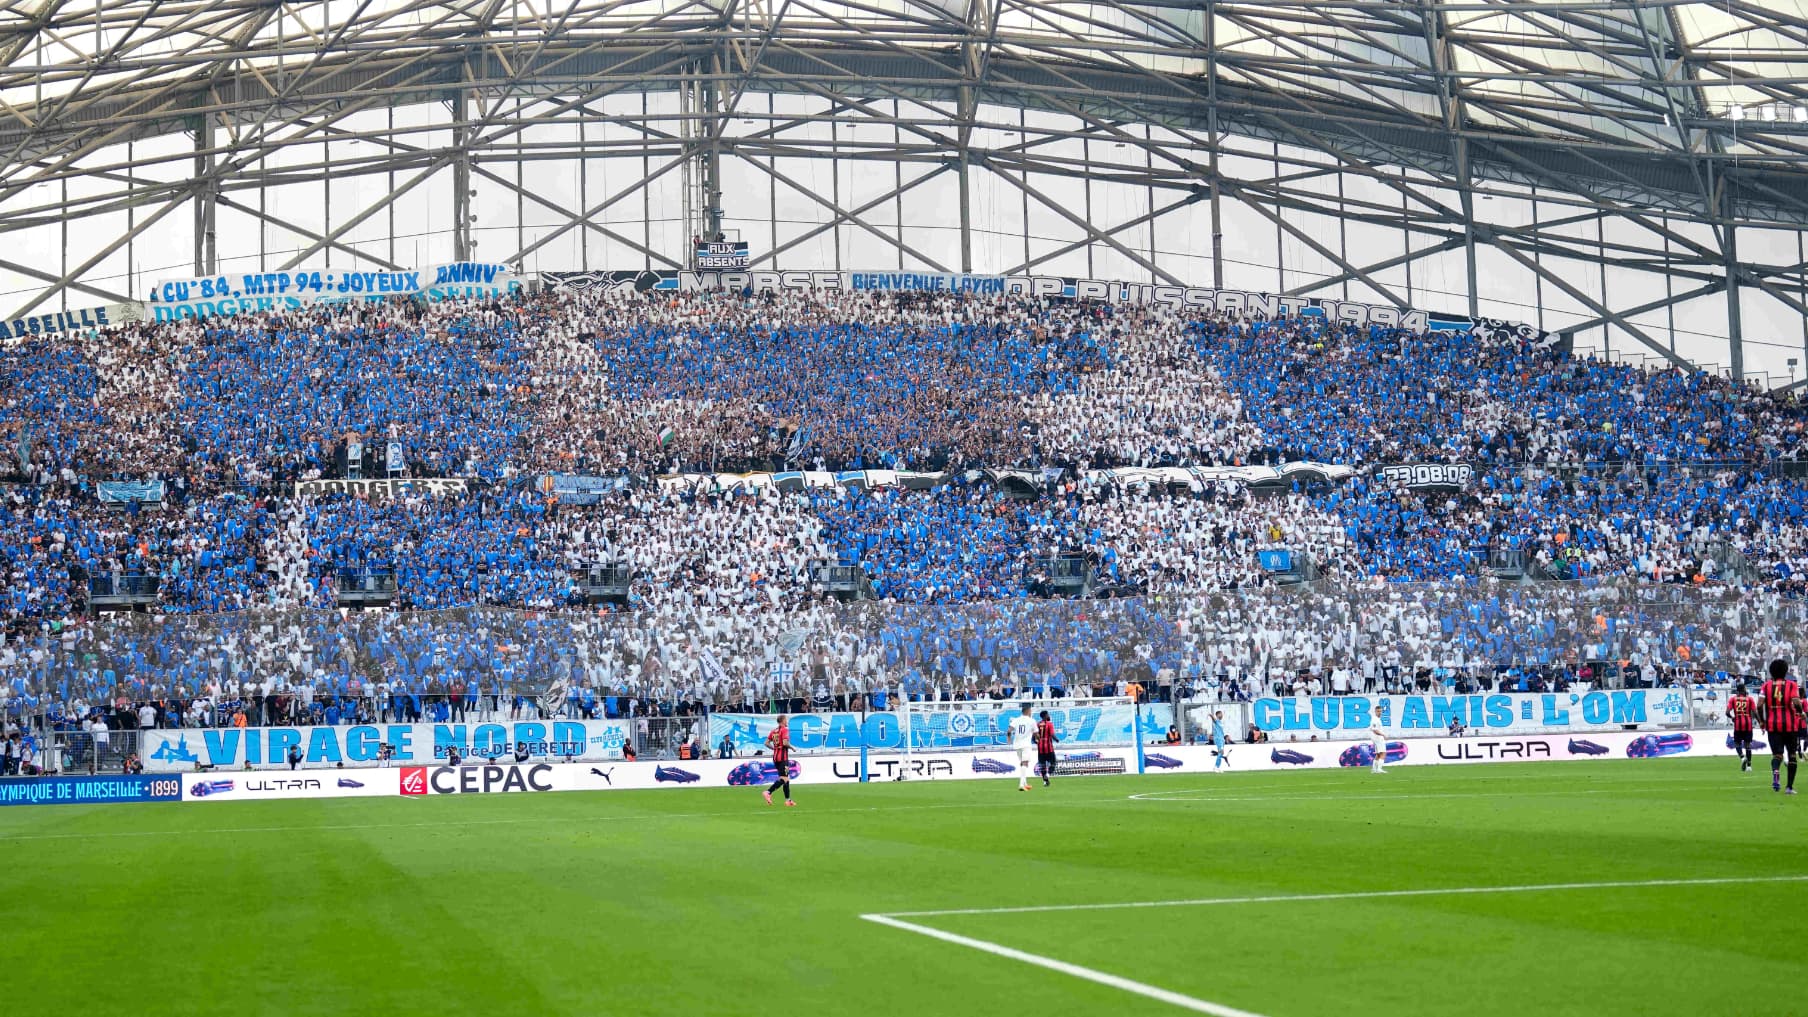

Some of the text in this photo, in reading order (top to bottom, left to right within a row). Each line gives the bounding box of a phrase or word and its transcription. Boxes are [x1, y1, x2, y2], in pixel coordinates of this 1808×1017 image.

[709, 244, 734, 254] AUX
[698, 256, 749, 267] ABSENTS
[243, 273, 290, 295] MTP
[337, 271, 420, 293] JOYEUX
[852, 272, 945, 292] BIENVENUE
[1774, 686, 1783, 701] 4
[1254, 696, 1372, 732] CLUB
[1400, 694, 1514, 728] AMIS
[1542, 690, 1647, 726] L'OM
[1735, 701, 1747, 712] 22
[202, 722, 587, 765] VIRAGE NORD
[433, 743, 489, 757] Parice
[1437, 740, 1551, 760] ULTRA
[246, 779, 321, 791] ULTRA
[430, 764, 554, 794] CEPAC
[57, 783, 72, 799] DE
[76, 781, 142, 800] MARSEILLE
